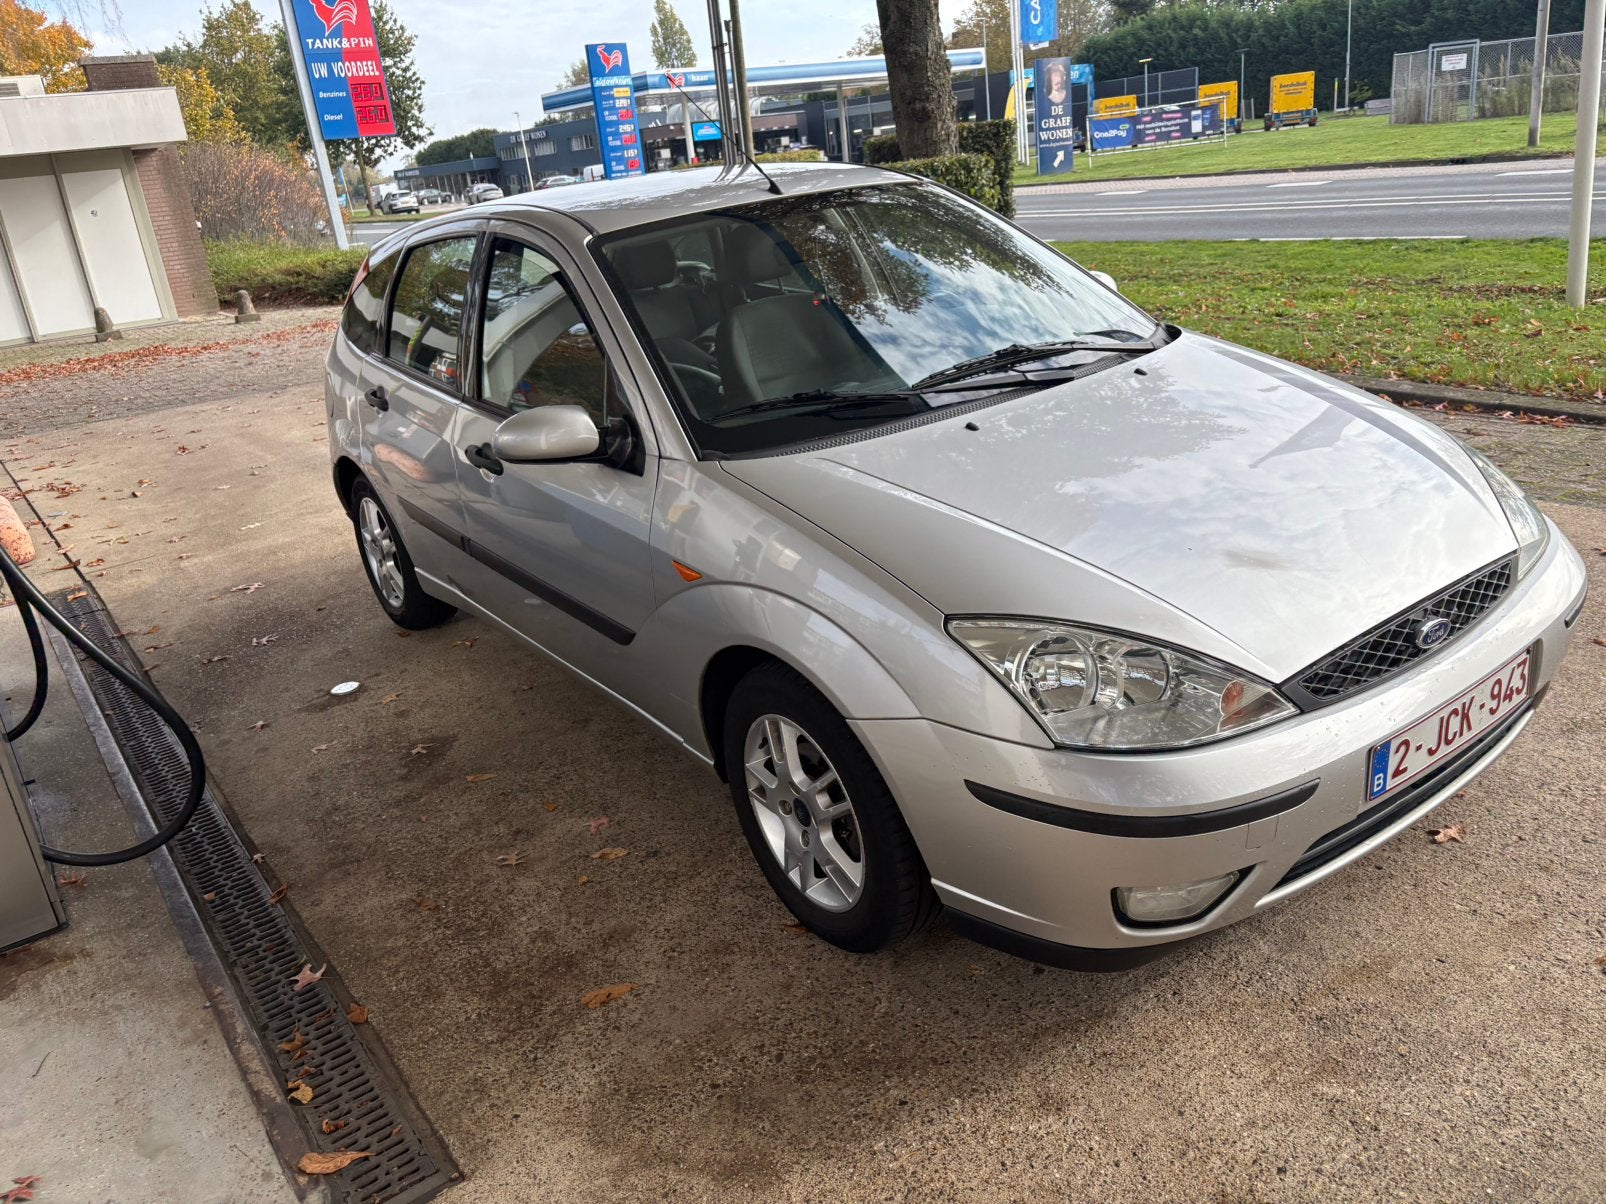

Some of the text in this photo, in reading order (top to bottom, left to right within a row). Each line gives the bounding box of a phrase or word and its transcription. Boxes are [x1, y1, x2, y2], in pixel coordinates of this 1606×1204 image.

[307, 37, 373, 49] TANK&PIN
[311, 61, 380, 79] UW VOORDEEL
[692, 74, 709, 82] haan
[319, 90, 347, 98] Benzines
[1051, 105, 1064, 116] DE
[324, 113, 343, 121] Diesel
[1041, 116, 1071, 129] GRAEF
[1039, 129, 1073, 141] WONEN
[1094, 129, 1127, 138] One2Pay
[1427, 626, 1444, 643] Ford
[1391, 657, 1528, 780] 2-JCK-943
[1373, 774, 1384, 792] B
